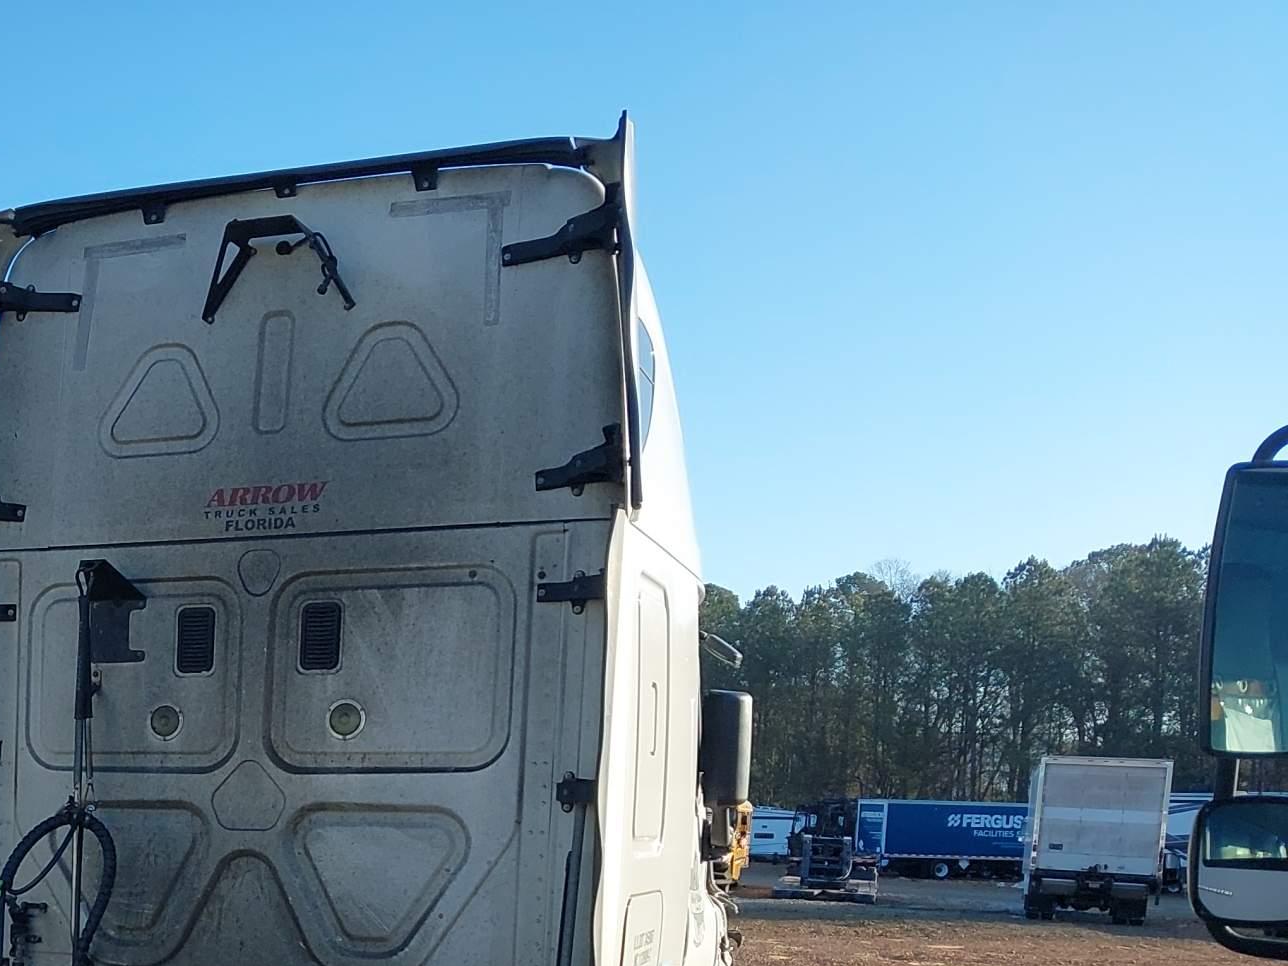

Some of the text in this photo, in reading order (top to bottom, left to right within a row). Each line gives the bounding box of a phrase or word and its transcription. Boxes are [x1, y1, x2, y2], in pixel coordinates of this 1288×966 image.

[204, 481, 329, 508] ARROW
[204, 503, 321, 520] TRUCK SALES
[225, 517, 296, 532] FLORIDA
[973, 829, 1015, 838] FACILITIES
